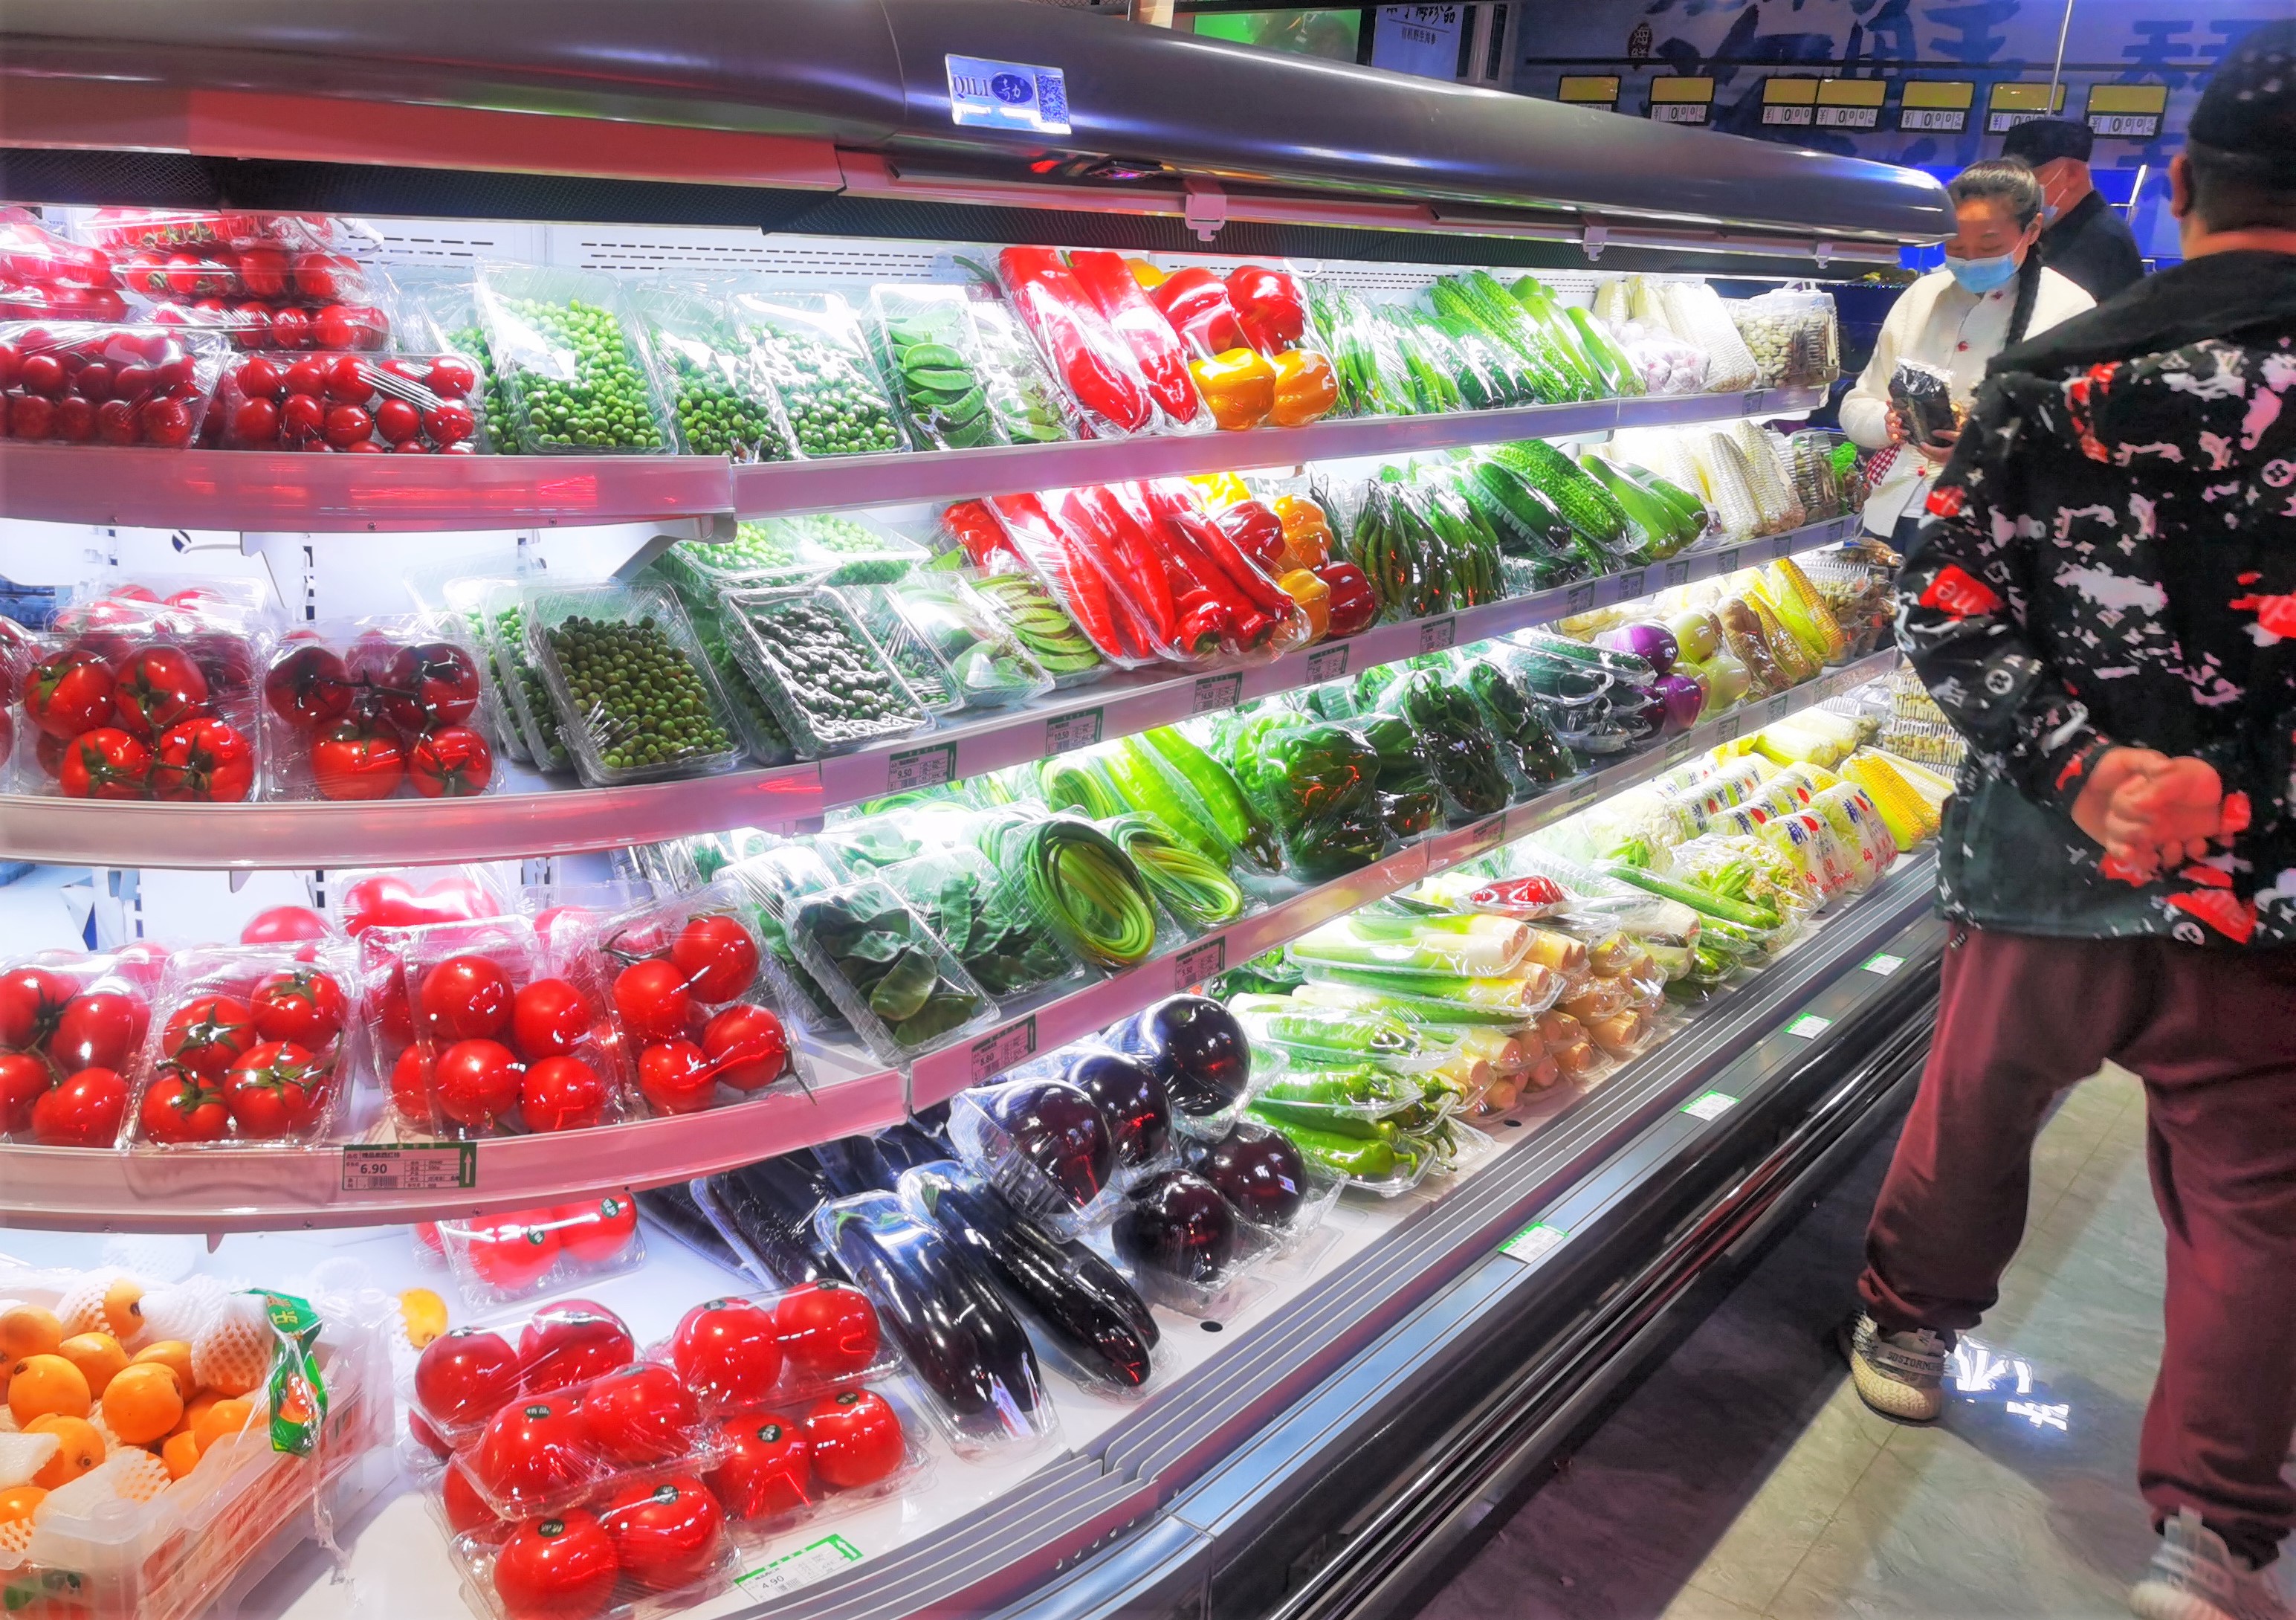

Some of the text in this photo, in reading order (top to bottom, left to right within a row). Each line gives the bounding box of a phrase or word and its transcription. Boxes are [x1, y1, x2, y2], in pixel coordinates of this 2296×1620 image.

[953, 75, 989, 99] QILI
[360, 1164, 387, 1174] 6.90
[761, 1575, 785, 1590] 4.90
